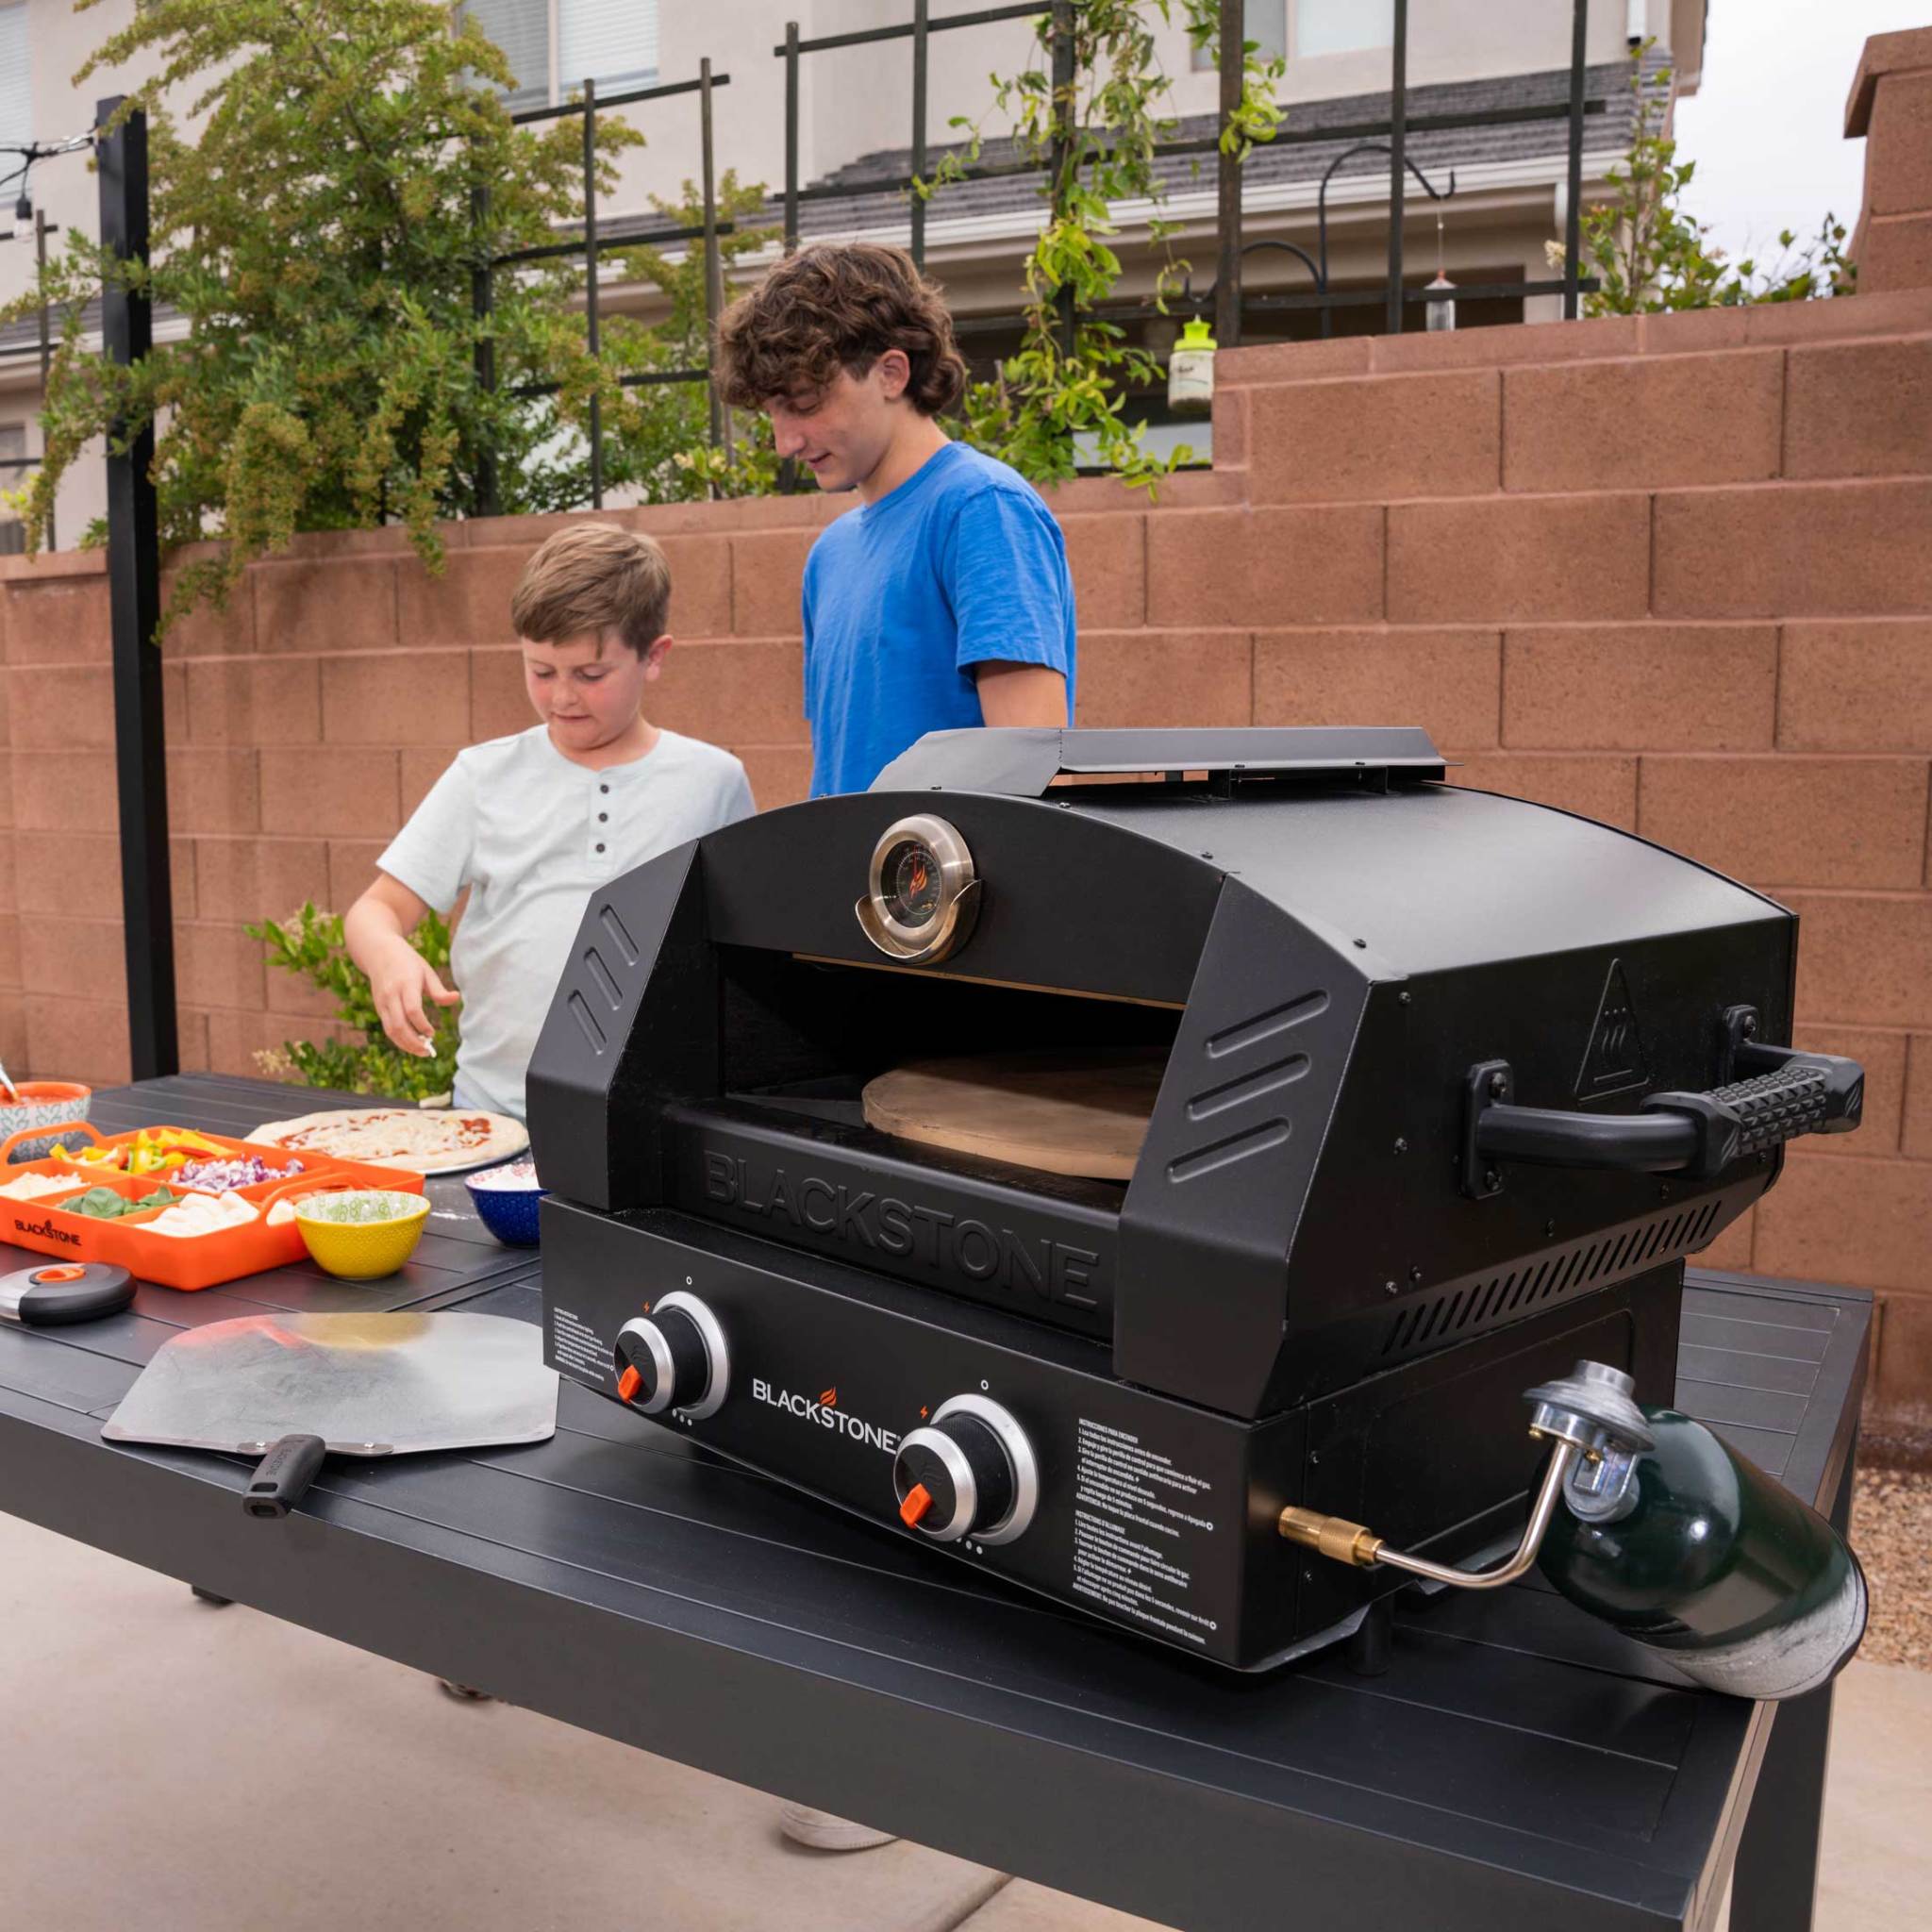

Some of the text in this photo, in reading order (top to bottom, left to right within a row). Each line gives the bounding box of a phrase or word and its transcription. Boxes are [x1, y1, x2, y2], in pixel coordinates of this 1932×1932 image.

[14, 1219, 81, 1246] BLACKSTONE
[704, 1150, 1100, 1309] BLACKSTONE
[753, 1378, 897, 1455] BLACKSTONE
